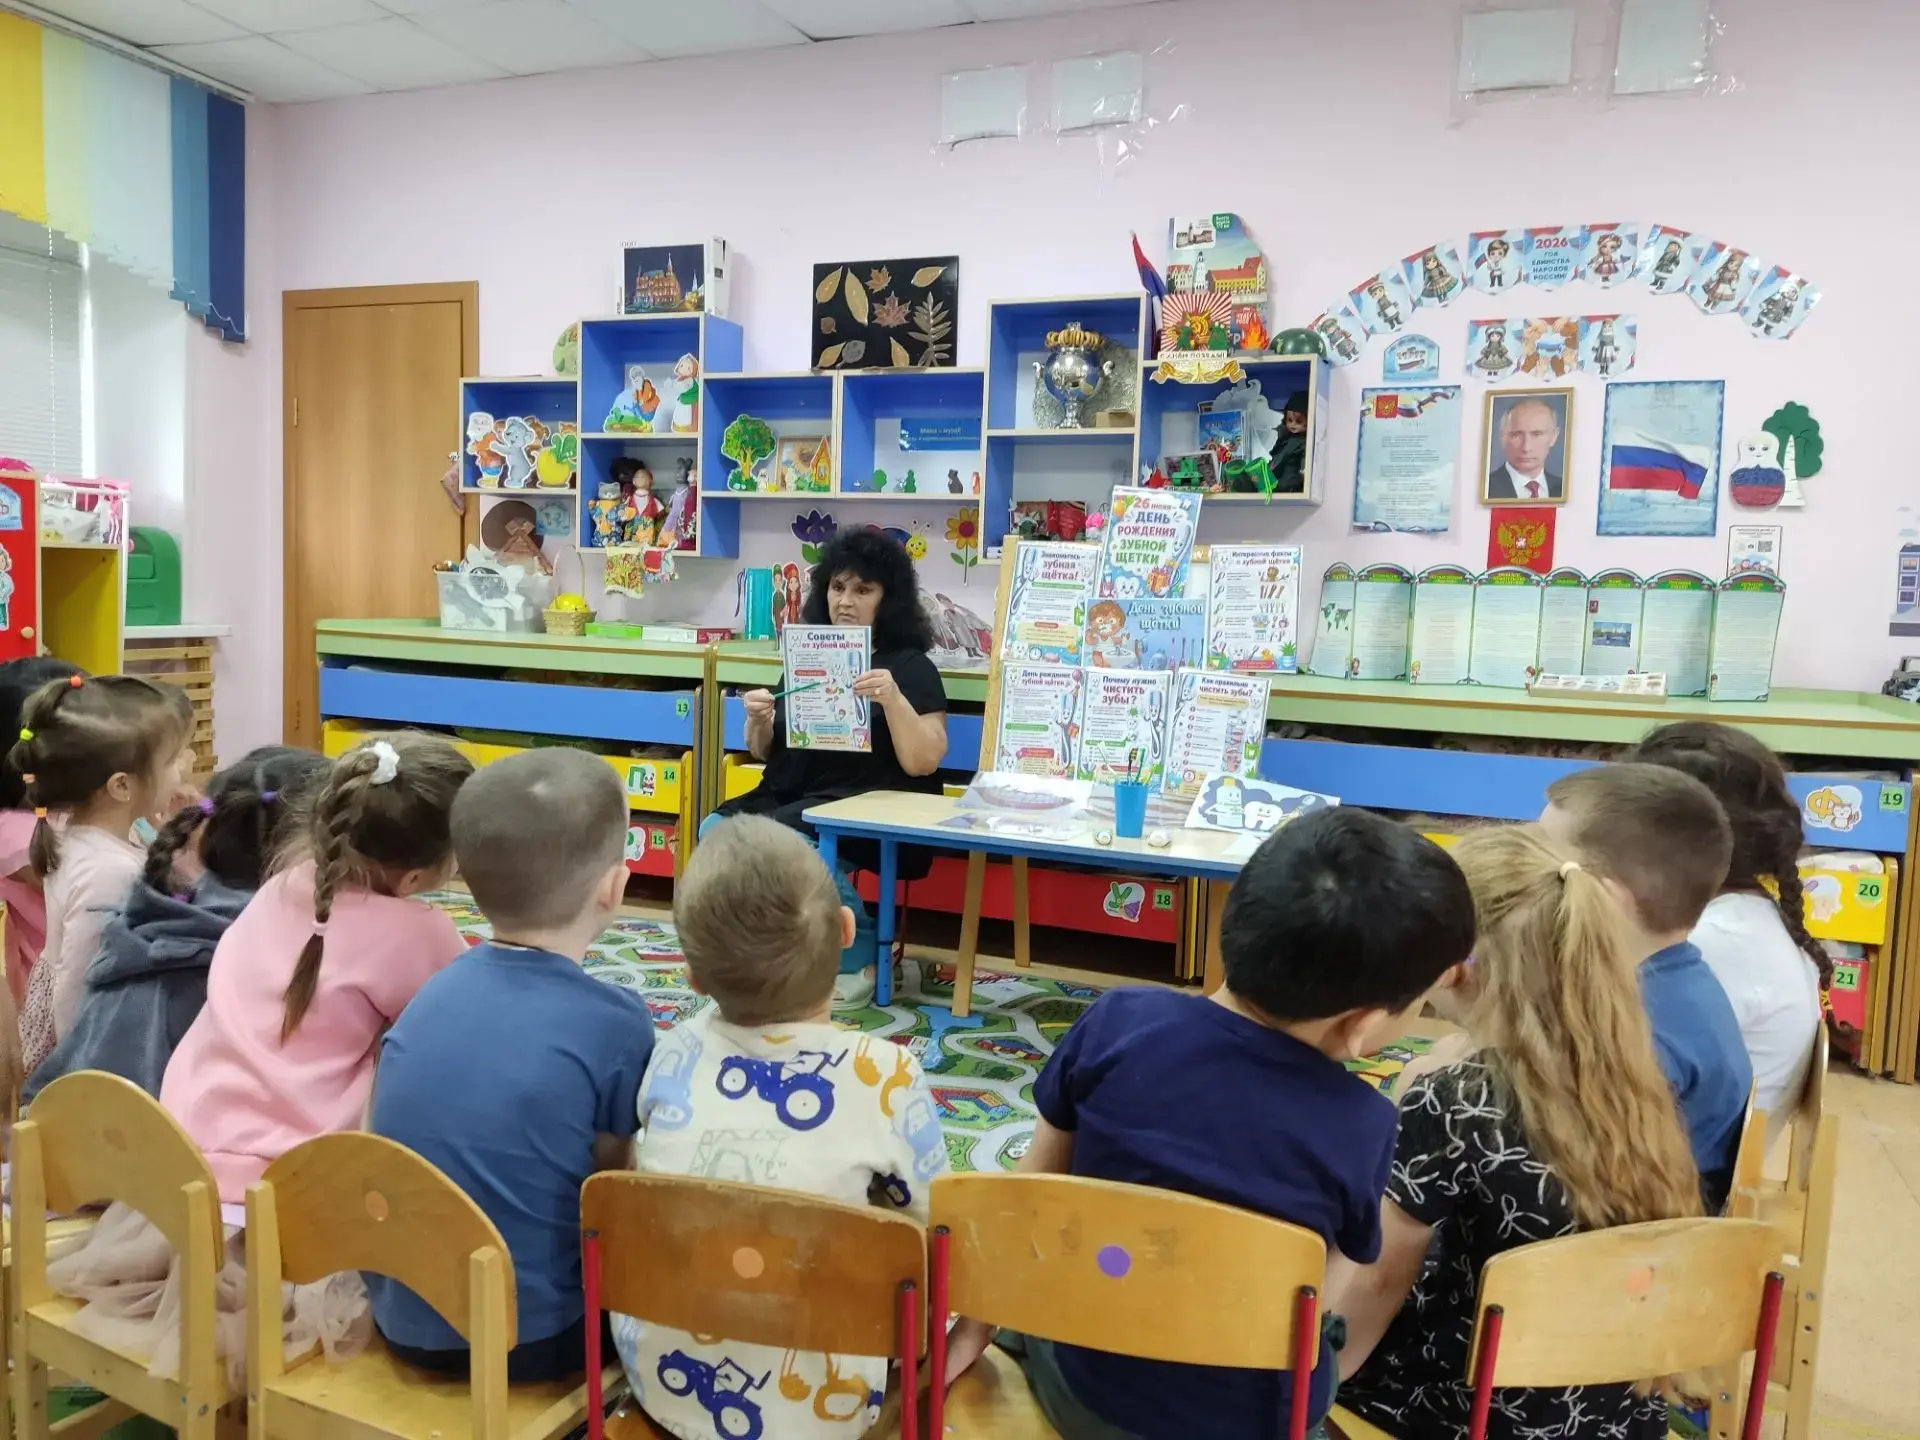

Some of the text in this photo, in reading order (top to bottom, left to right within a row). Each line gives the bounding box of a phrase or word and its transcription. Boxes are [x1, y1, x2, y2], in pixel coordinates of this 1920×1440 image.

[1535, 236, 1569, 249] 2026
[1531, 258, 1570, 266] ЕДИНСТВА
[1532, 265, 1569, 273] НАРОДОВ
[1134, 496, 1150, 509] 26
[1135, 511, 1171, 524] ДЕНЬ
[1117, 525, 1176, 538] РОЖДЕНИЯ
[1119, 538, 1168, 552] ЗУБНОЙ
[1115, 552, 1160, 564] ЩЕТКИ
[1043, 559, 1076, 569] зубная
[1041, 569, 1079, 580] щётка!
[1126, 601, 1204, 619] День зубной
[807, 631, 845, 641] Советы
[811, 640, 838, 650] зубной
[838, 640, 863, 650] щётки
[1022, 669, 1039, 678] День
[1103, 675, 1130, 685] Почему
[1201, 676, 1249, 688] Как правильно
[1103, 685, 1145, 694] чистить
[1199, 686, 1229, 694] чистить
[677, 703, 689, 713] 13
[663, 770, 675, 780] 14
[1882, 793, 1903, 806] 19
[653, 835, 664, 845] 15
[1858, 883, 1880, 897] 20
[1155, 894, 1171, 905] 18
[1835, 971, 1855, 985] 21
